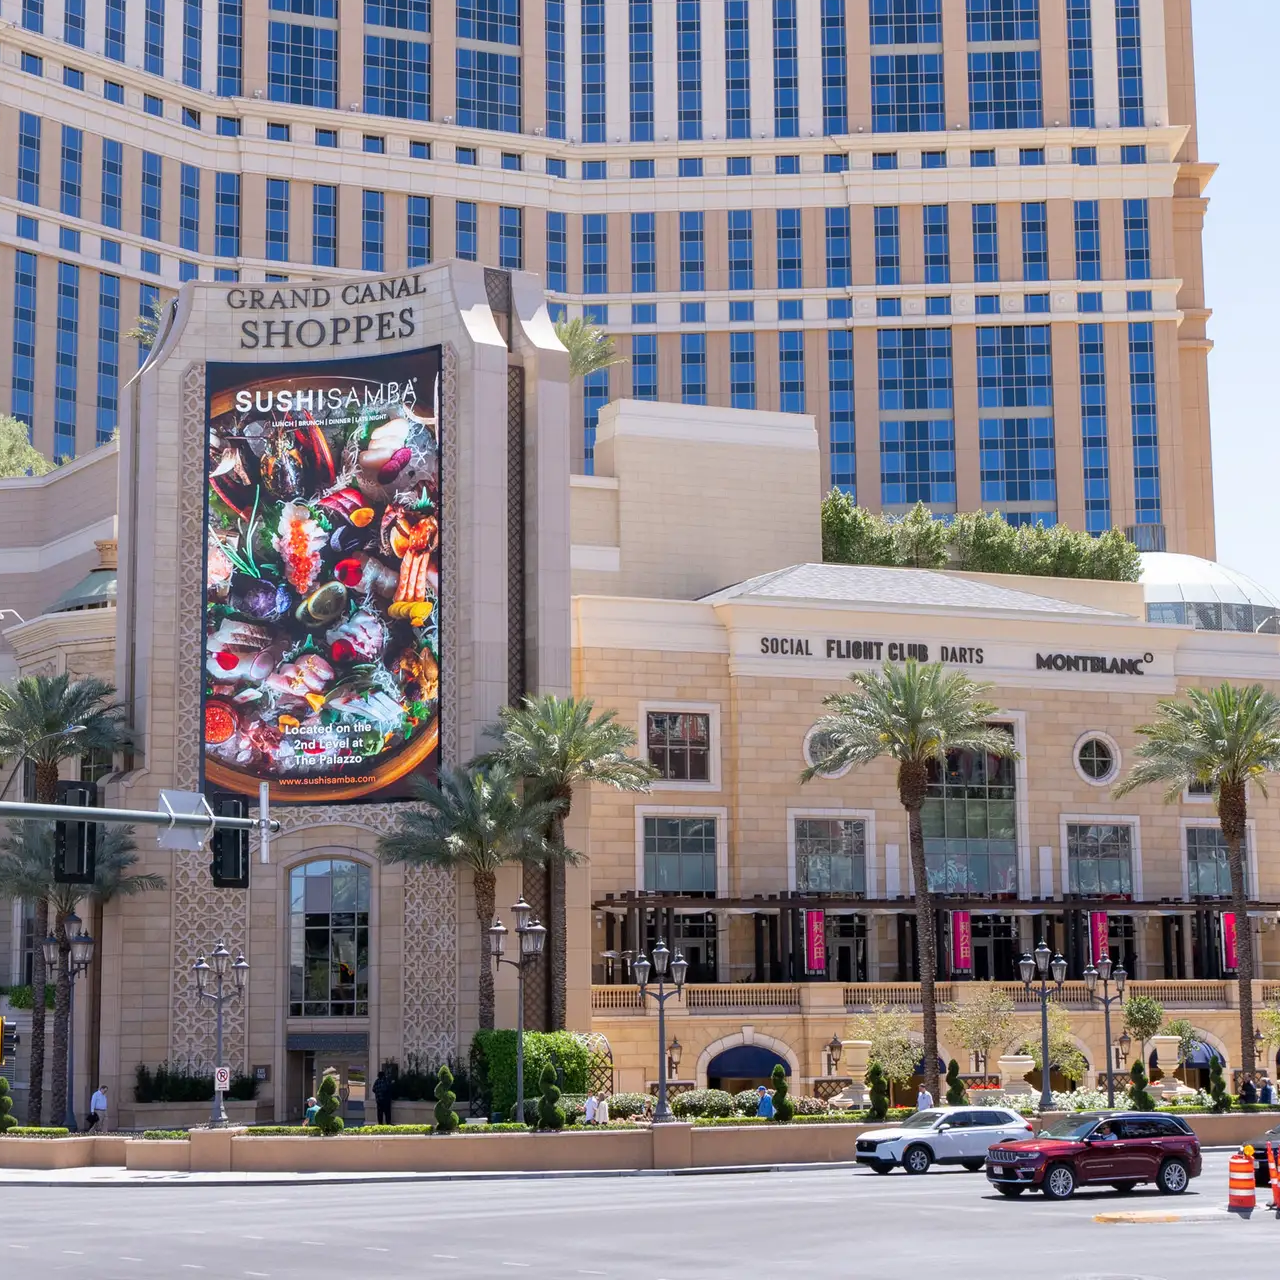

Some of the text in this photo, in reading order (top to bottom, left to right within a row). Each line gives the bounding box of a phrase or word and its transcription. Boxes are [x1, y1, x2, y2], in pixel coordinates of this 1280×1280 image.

[226, 275, 427, 310] GRAND CANAL
[240, 307, 416, 350] SHOPPES
[235, 378, 417, 413] SUSHISAMBA
[298, 419, 325, 427] BRUNCH
[760, 637, 984, 664] SOCIAL FLIGHT CLUB DARTS
[1036, 652, 1145, 676] MONTBLANC
[285, 721, 372, 735] Located on the
[294, 738, 364, 750] 2nd Level at
[294, 754, 363, 765] The Palazzo
[279, 775, 376, 786] www.sushisamba.com
